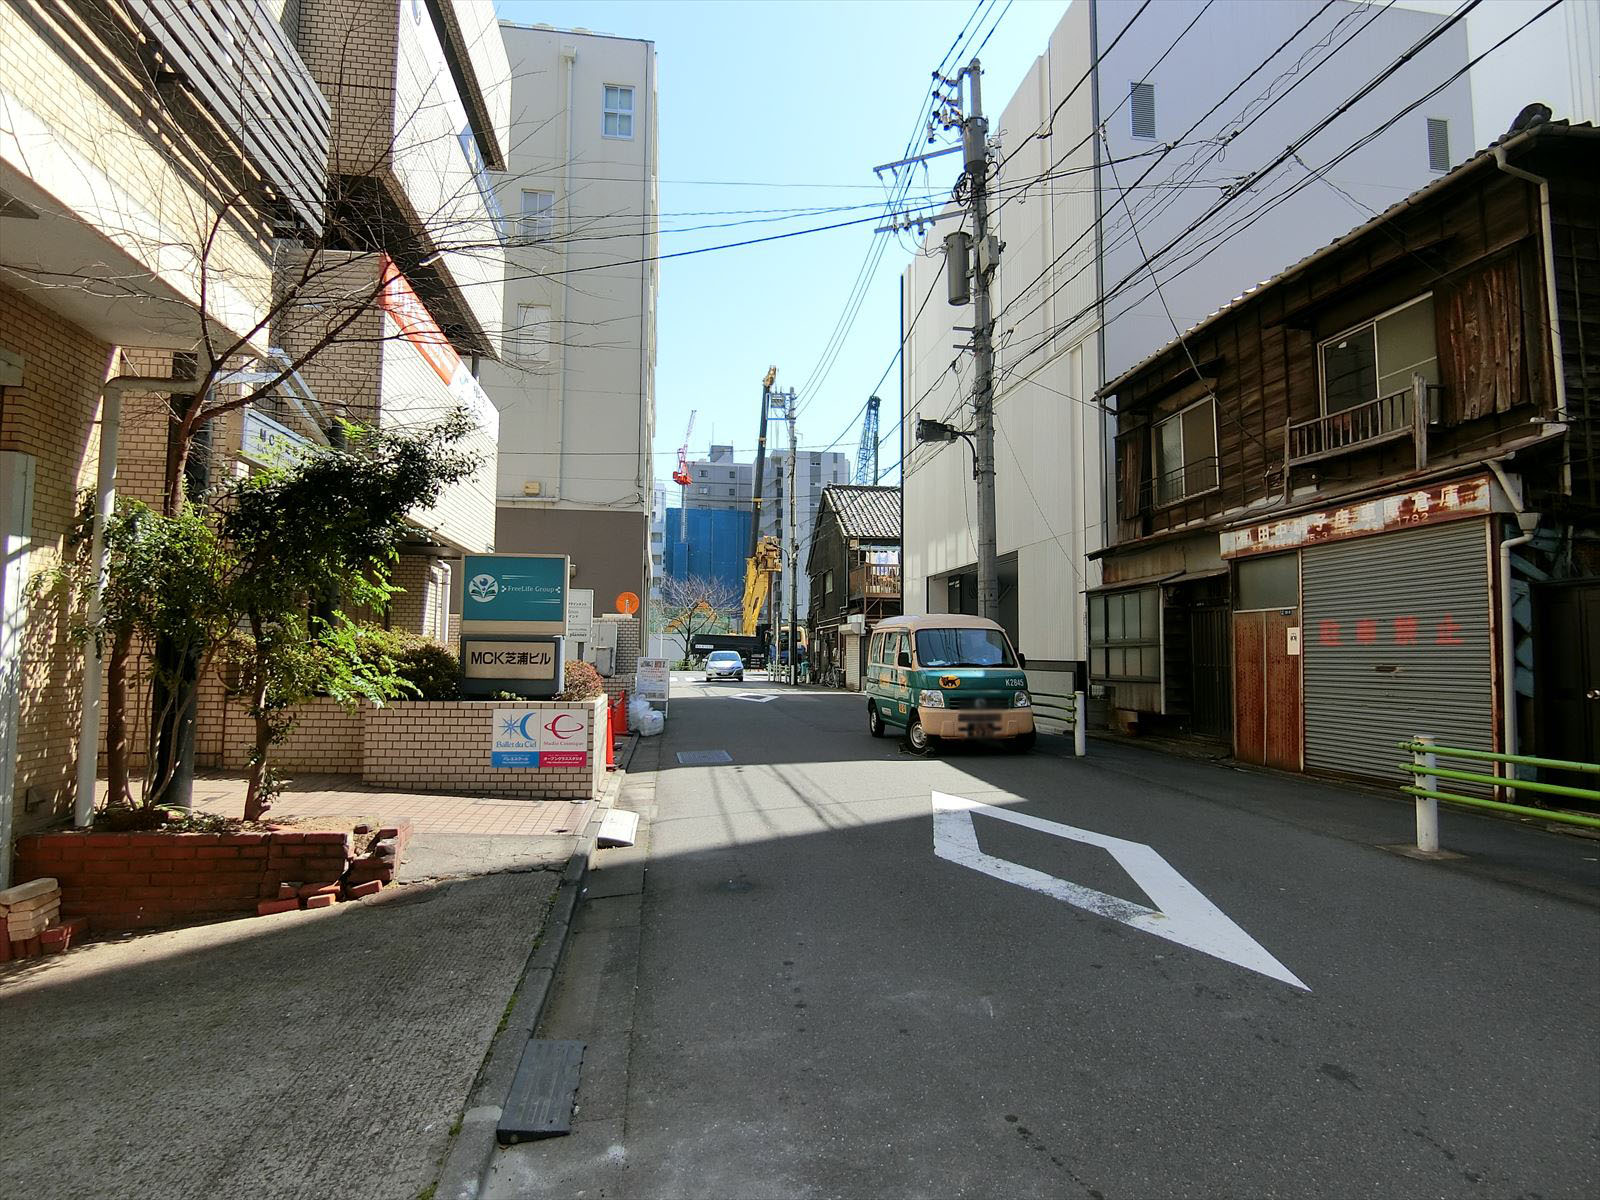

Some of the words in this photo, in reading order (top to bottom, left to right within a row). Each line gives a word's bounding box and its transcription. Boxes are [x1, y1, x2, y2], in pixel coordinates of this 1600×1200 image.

[535, 585, 555, 593] Group
[470, 651, 551, 666] MCK芝浦ビル
